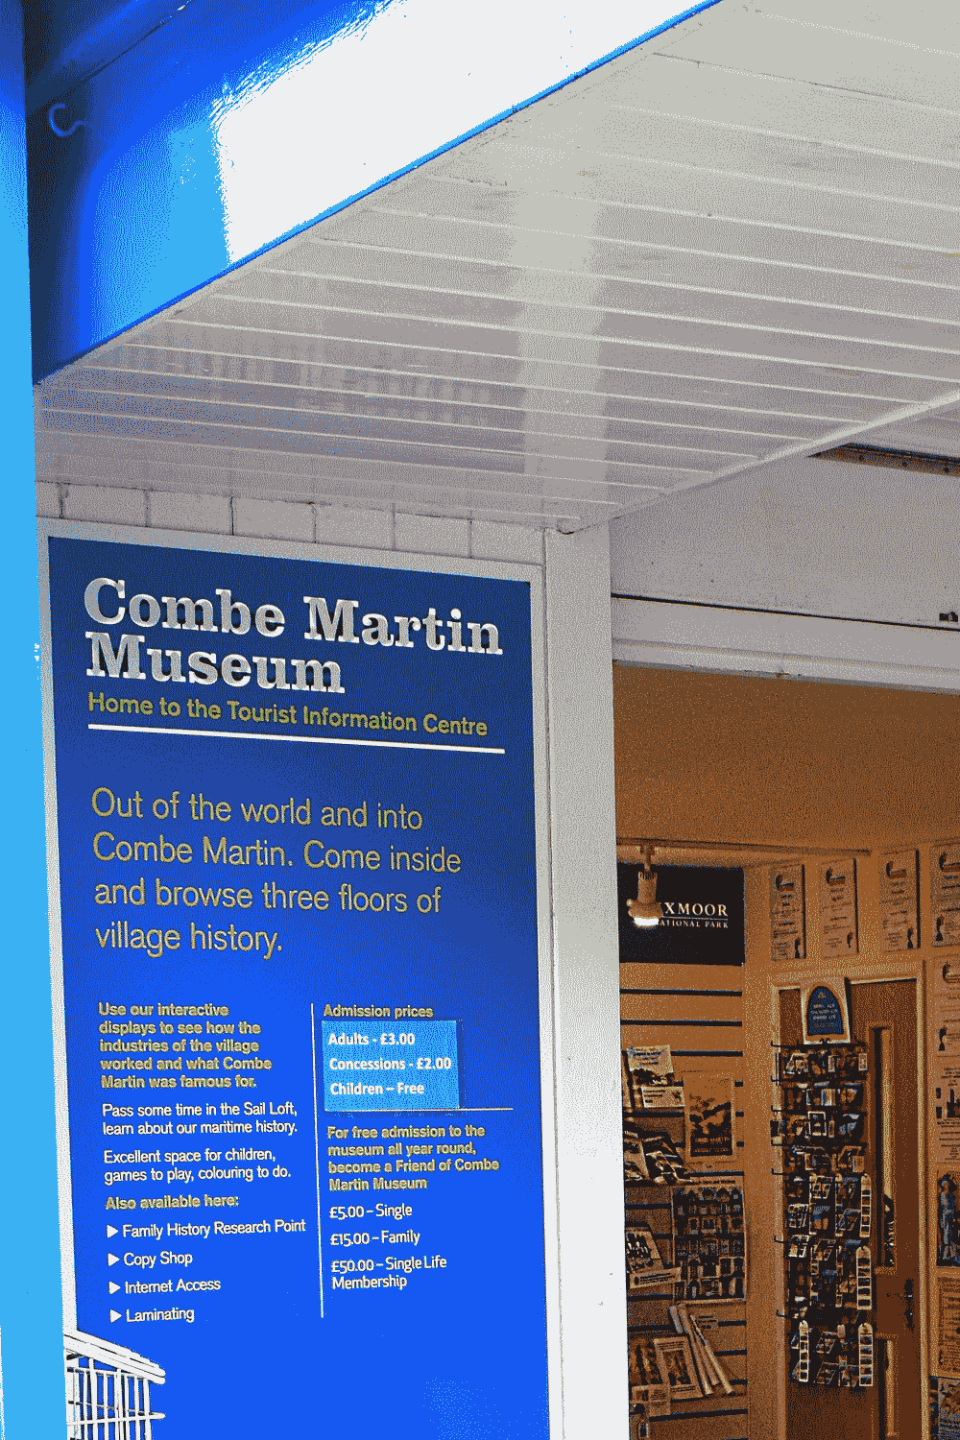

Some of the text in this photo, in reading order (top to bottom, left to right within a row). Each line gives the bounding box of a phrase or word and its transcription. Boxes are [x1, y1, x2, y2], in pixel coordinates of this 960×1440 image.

[84, 577, 503, 655] Combe Martin
[85, 632, 345, 693] Museum
[88, 691, 488, 735] Home to the Tourist Information Centre
[92, 787, 423, 830] Out of the world and into
[93, 831, 461, 872] Combe Martin. Come inside
[94, 877, 442, 913] and browse three floors of
[665, 902, 728, 916] XMOOR
[96, 920, 282, 959] village history.
[98, 1001, 229, 1017] Use our interactive
[323, 1003, 434, 1020] Admission prices
[98, 1020, 261, 1037] displays to see how the
[99, 1038, 260, 1055] industries of the village
[328, 1032, 416, 1046] Adults £3.00
[99, 1055, 273, 1071] worked and what Combe
[329, 1056, 452, 1071] Concessions £2.00
[100, 1074, 257, 1089] Martin was famous for.
[329, 1081, 425, 1096] Children Free
[102, 1100, 298, 1118] Pass some time in the Sail Loft,
[102, 1119, 298, 1136] learn about our maritime history.
[105, 1193, 239, 1210] Also available here:
[329, 1202, 413, 1221] £5.00 Single
[122, 1218, 306, 1241] Family History Research Point
[330, 1229, 421, 1248] £15.00 Family
[123, 1250, 193, 1270] Copy Shop
[330, 1254, 447, 1275] £50.00 Single Life
[124, 1278, 222, 1294] Internet Access
[331, 1274, 408, 1290] Membership
[125, 1307, 195, 1324] Laminating
